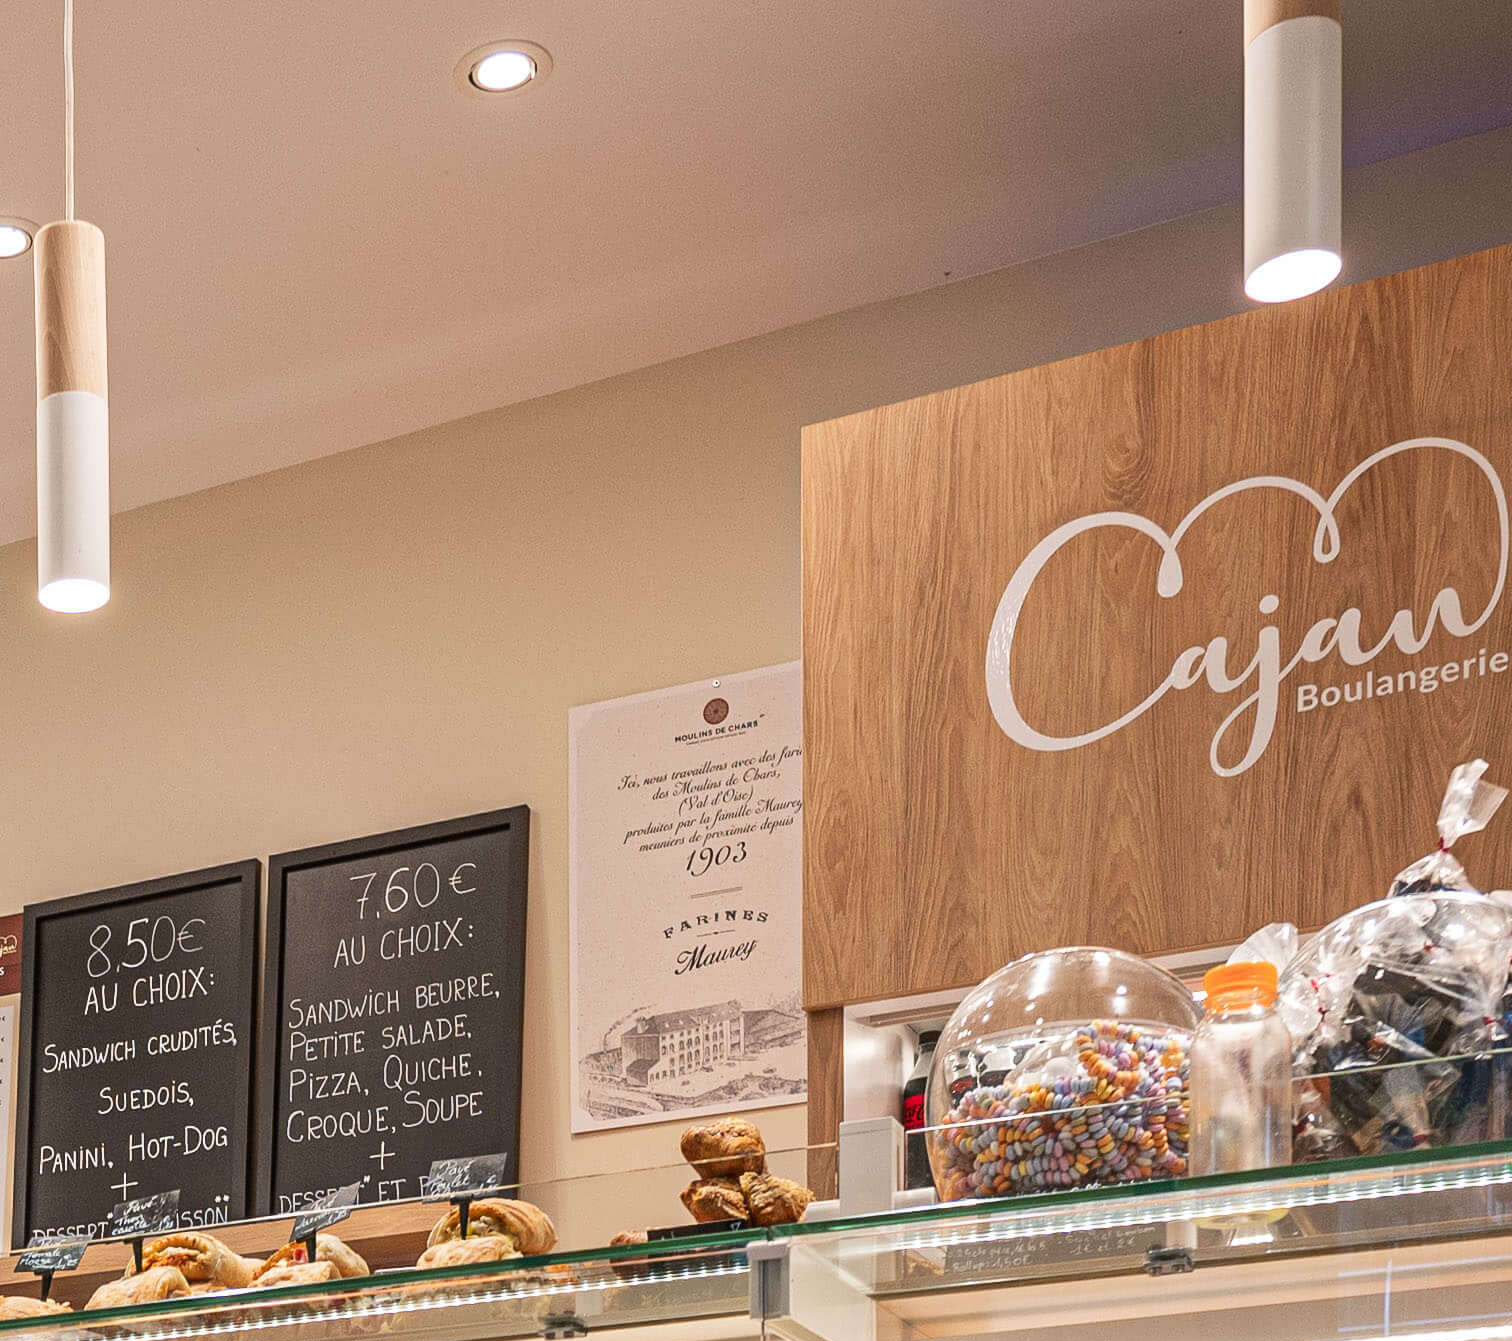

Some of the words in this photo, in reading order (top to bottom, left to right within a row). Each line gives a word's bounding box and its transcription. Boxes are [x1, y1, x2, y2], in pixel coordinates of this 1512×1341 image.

[985, 437, 1509, 777] Cajan
[1296, 647, 1509, 713] Boulangerie
[675, 729, 713, 743] MOULINS
[715, 726, 725, 734] DE
[728, 720, 758, 732] CHARS
[643, 775, 668, 786] nous
[671, 761, 728, 781] travaillons
[731, 757, 756, 768] avec
[758, 753, 776, 767] des
[652, 788, 669, 800] des
[673, 779, 721, 797] Moulins
[725, 774, 738, 786] de
[743, 767, 781, 783] Chars,
[623, 822, 673, 844] produites
[675, 819, 696, 836] par
[700, 814, 710, 825] la
[707, 809, 752, 829] famille
[639, 838, 685, 852] meuniers
[689, 834, 702, 844] de
[760, 816, 794, 835] depuis
[686, 841, 748, 877] 1903
[334, 935, 366, 968] AU
[380, 917, 474, 960] CHOIX:
[663, 909, 769, 940] FARINES
[87, 915, 206, 978] 8,50€
[674, 938, 759, 975] Maurey
[84, 982, 118, 1016] AU
[132, 966, 215, 1007] CHOIX:
[288, 989, 400, 1029] SANDWICH
[415, 972, 500, 1009] BEURRE,
[42, 1039, 136, 1073] SANDWICH
[147, 1018, 238, 1056] CRUDITÉS,
[290, 1031, 365, 1062] PETITE
[382, 1013, 472, 1050] SALADE,
[289, 1069, 369, 1103] PIZZA,
[383, 1053, 483, 1091] QUICHE,
[98, 1079, 194, 1115] SUEDOIS,
[286, 1106, 396, 1143] CROQUE,
[402, 1090, 484, 1128] SOUPE
[129, 1125, 228, 1162] HOT-DOG
[378, 1178, 406, 1201] ET
